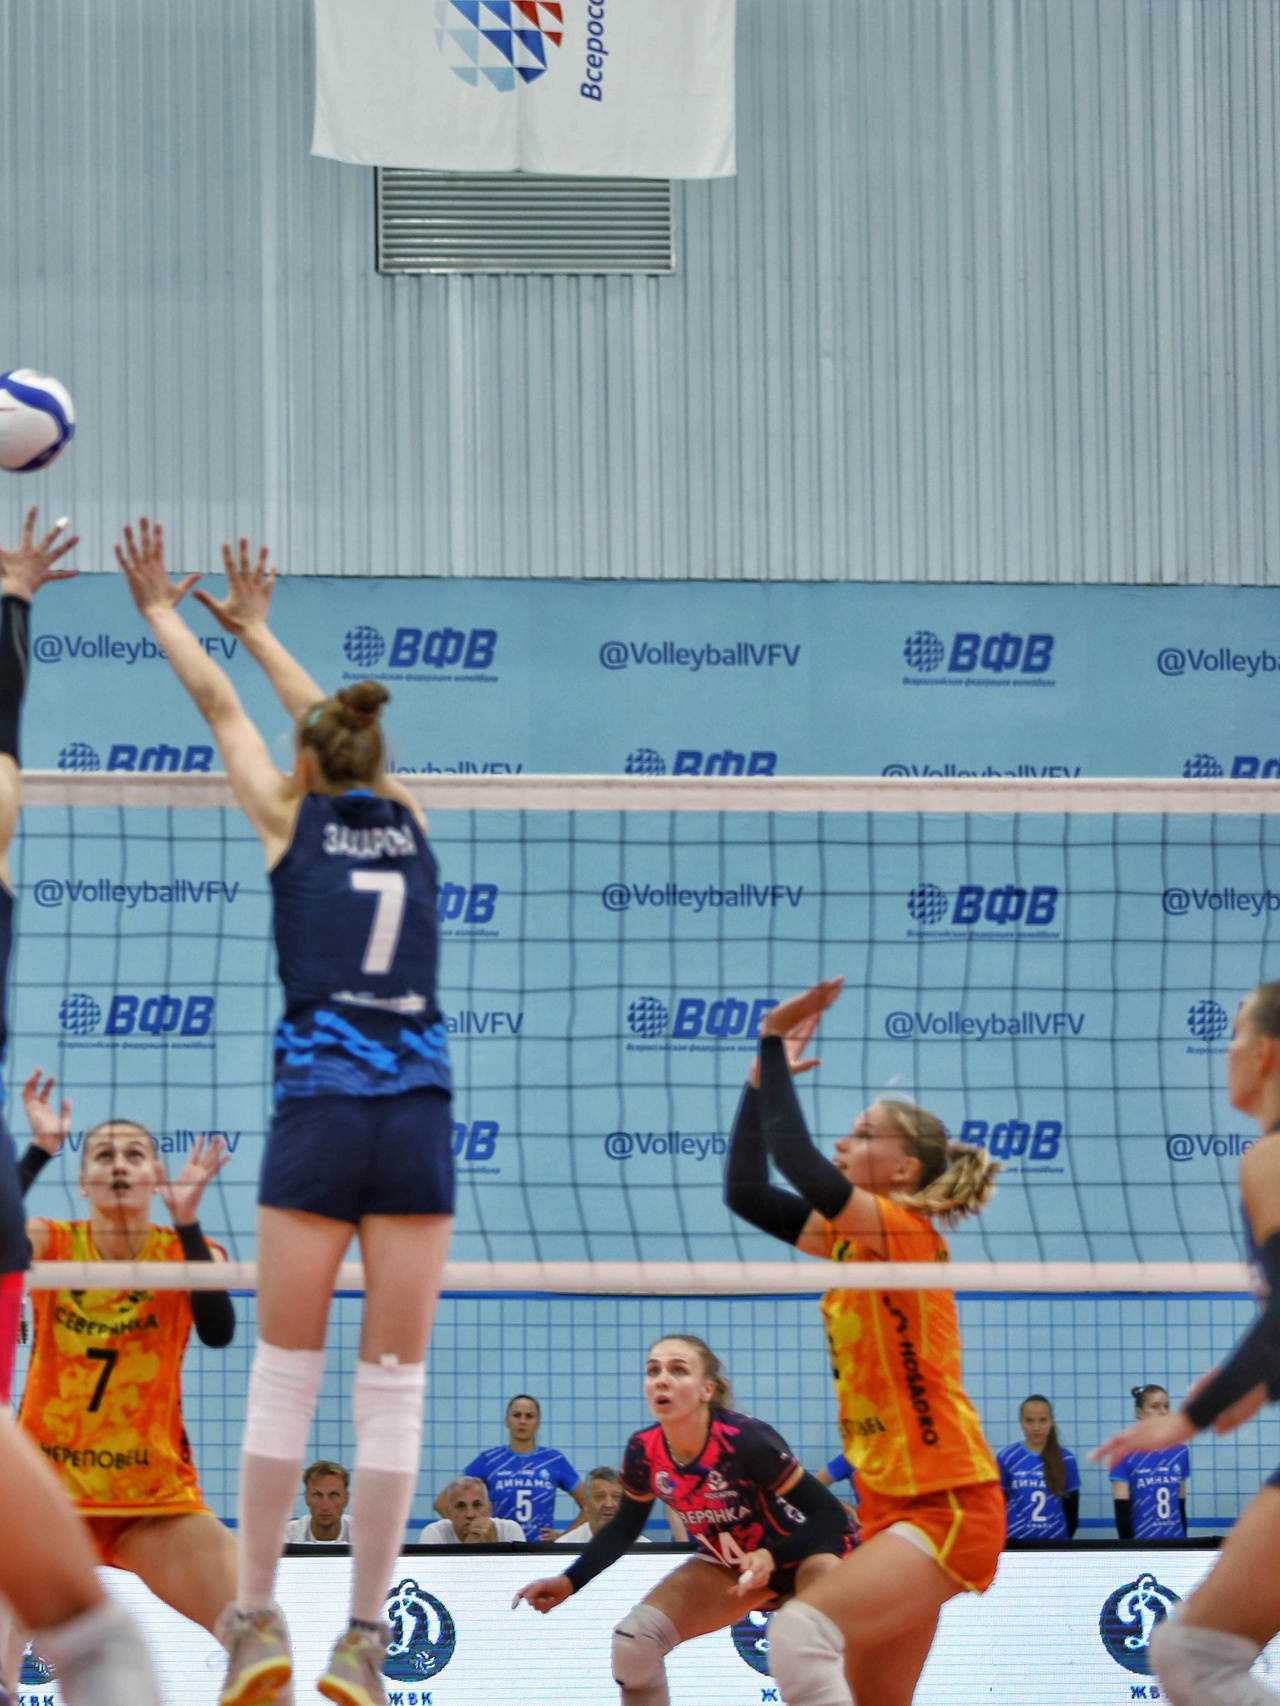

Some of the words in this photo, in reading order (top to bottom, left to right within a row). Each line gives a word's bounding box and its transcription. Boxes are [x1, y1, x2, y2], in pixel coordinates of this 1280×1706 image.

[33, 634, 238, 665] @VolleybFV
[388, 626, 498, 669] ВФВ
[599, 641, 800, 671] @VolleyballVFV
[947, 631, 1055, 674] ВФВ
[106, 744, 214, 772] ВФВ
[672, 749, 778, 776] ВФВ
[33, 879, 239, 909] @VolleyballVFV
[437, 882, 499, 923] ФВ
[602, 883, 803, 913] @VolleyballVFV
[951, 884, 1059, 926] ВФВ
[350, 869, 407, 975] 7
[104, 994, 215, 1037] ВФВ
[884, 1011, 1084, 1041] @VolleyballVFV
[604, 1131, 727, 1161] @Volleyb
[960, 1119, 1063, 1161] ВФВ
[86, 1347, 119, 1413] 7
[495, 1478, 554, 1491] ДИНАМО
[1011, 1478, 1047, 1489] ДИНА
[1136, 1475, 1182, 1489] ДИНАМ
[515, 1489, 533, 1522] 5
[680, 1505, 752, 1524] ВЕРЯНКА
[1030, 1490, 1048, 1522] 2
[1155, 1486, 1172, 1519] 8
[387, 1692, 433, 1706] ЖВК
[1130, 1685, 1160, 1699] ЖВ
